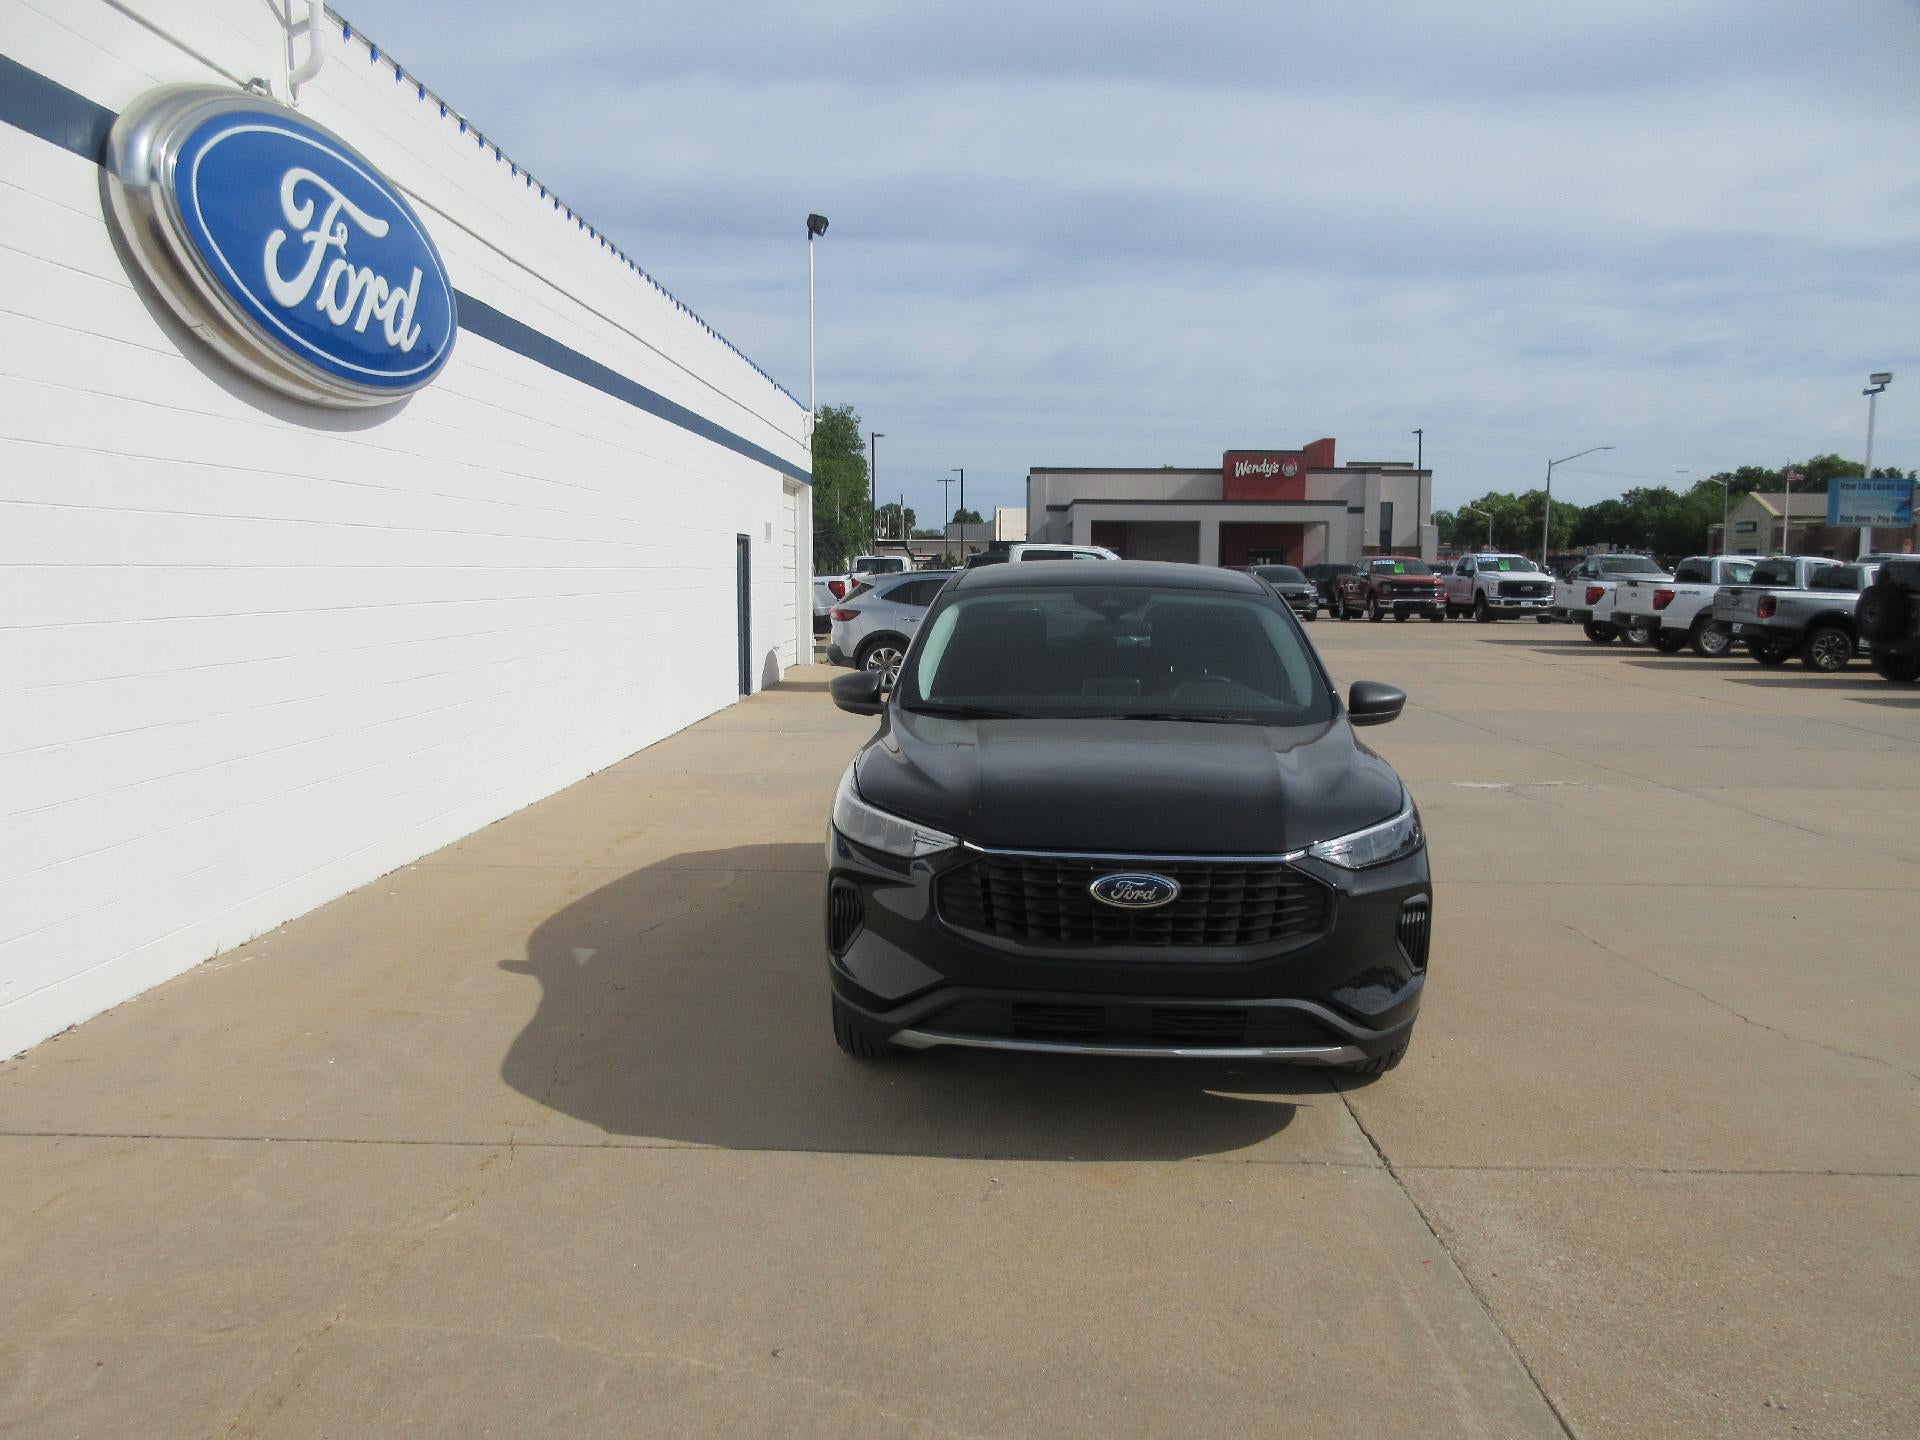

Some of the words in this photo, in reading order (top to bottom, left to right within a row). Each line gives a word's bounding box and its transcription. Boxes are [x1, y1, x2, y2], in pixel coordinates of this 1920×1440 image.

[264, 167, 423, 353] Ford
[1235, 458, 1280, 478] Wendy's
[1111, 880, 1158, 900] Ford
